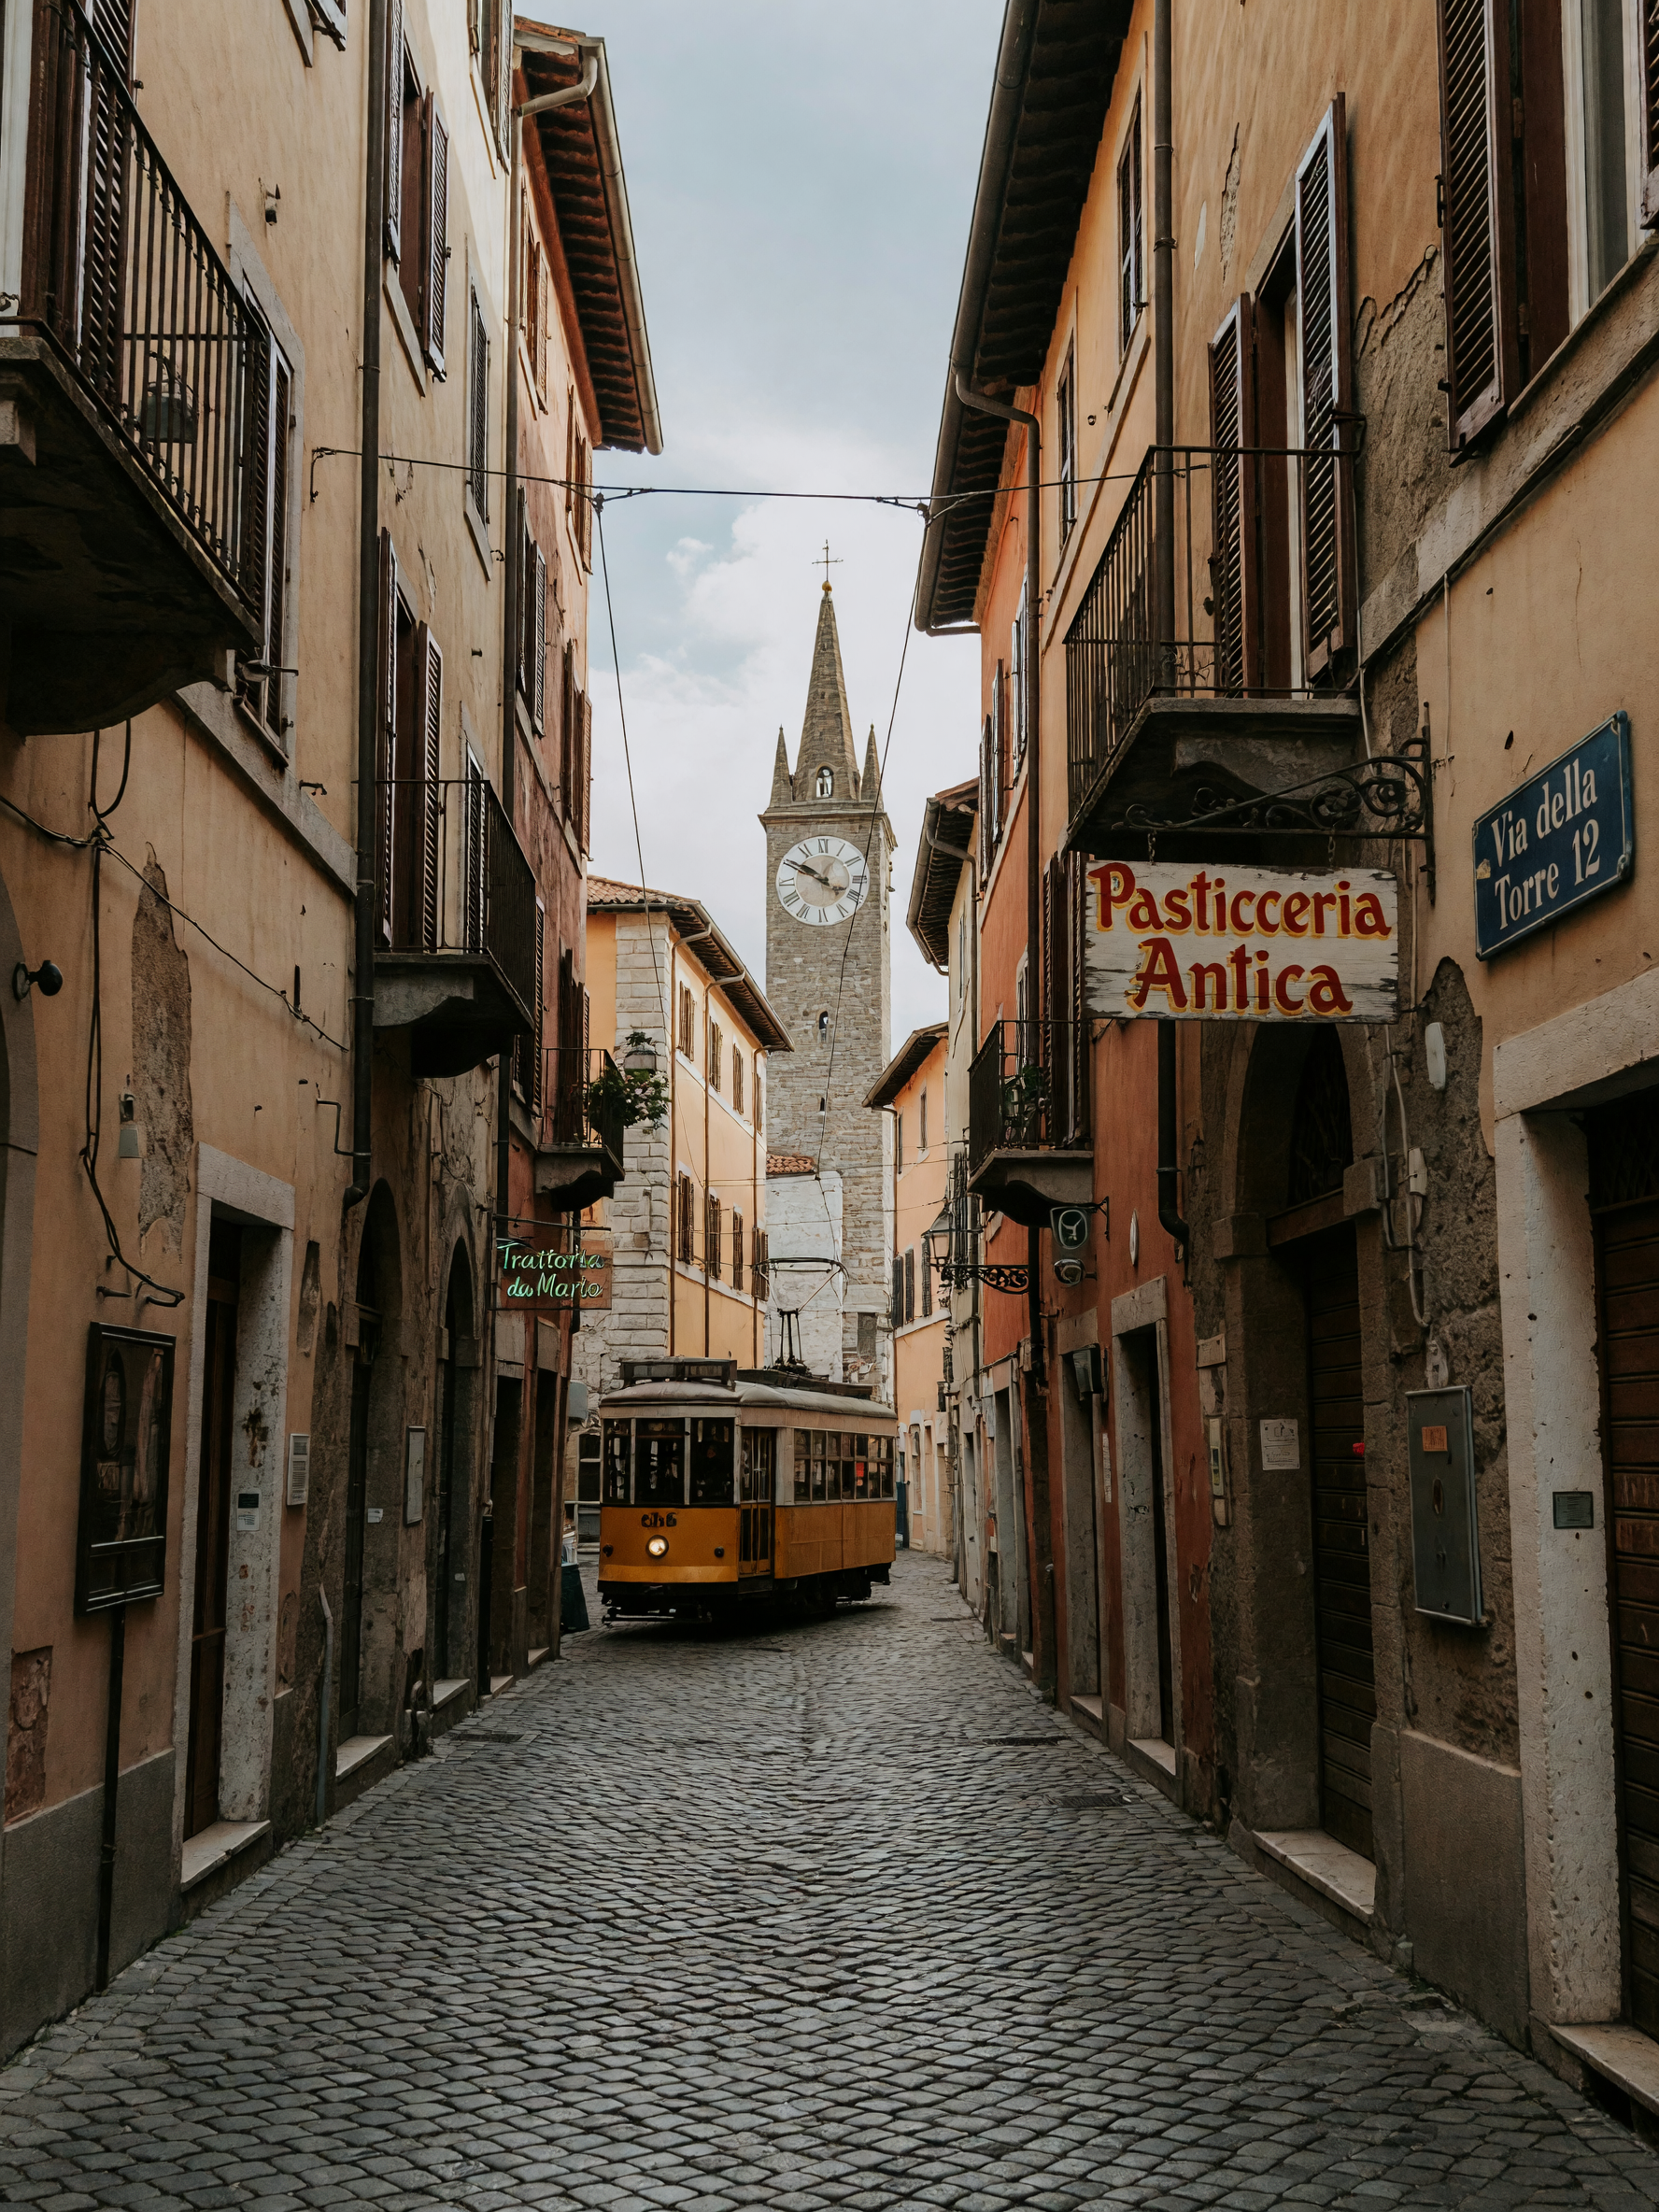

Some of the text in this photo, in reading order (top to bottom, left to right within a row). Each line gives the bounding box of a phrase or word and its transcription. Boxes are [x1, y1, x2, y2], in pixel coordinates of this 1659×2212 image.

[1491, 758, 1598, 868] Via della
[1087, 861, 1393, 939] Pasticceria
[1495, 818, 1601, 930] Torre 12
[1126, 936, 1354, 1016] Antica
